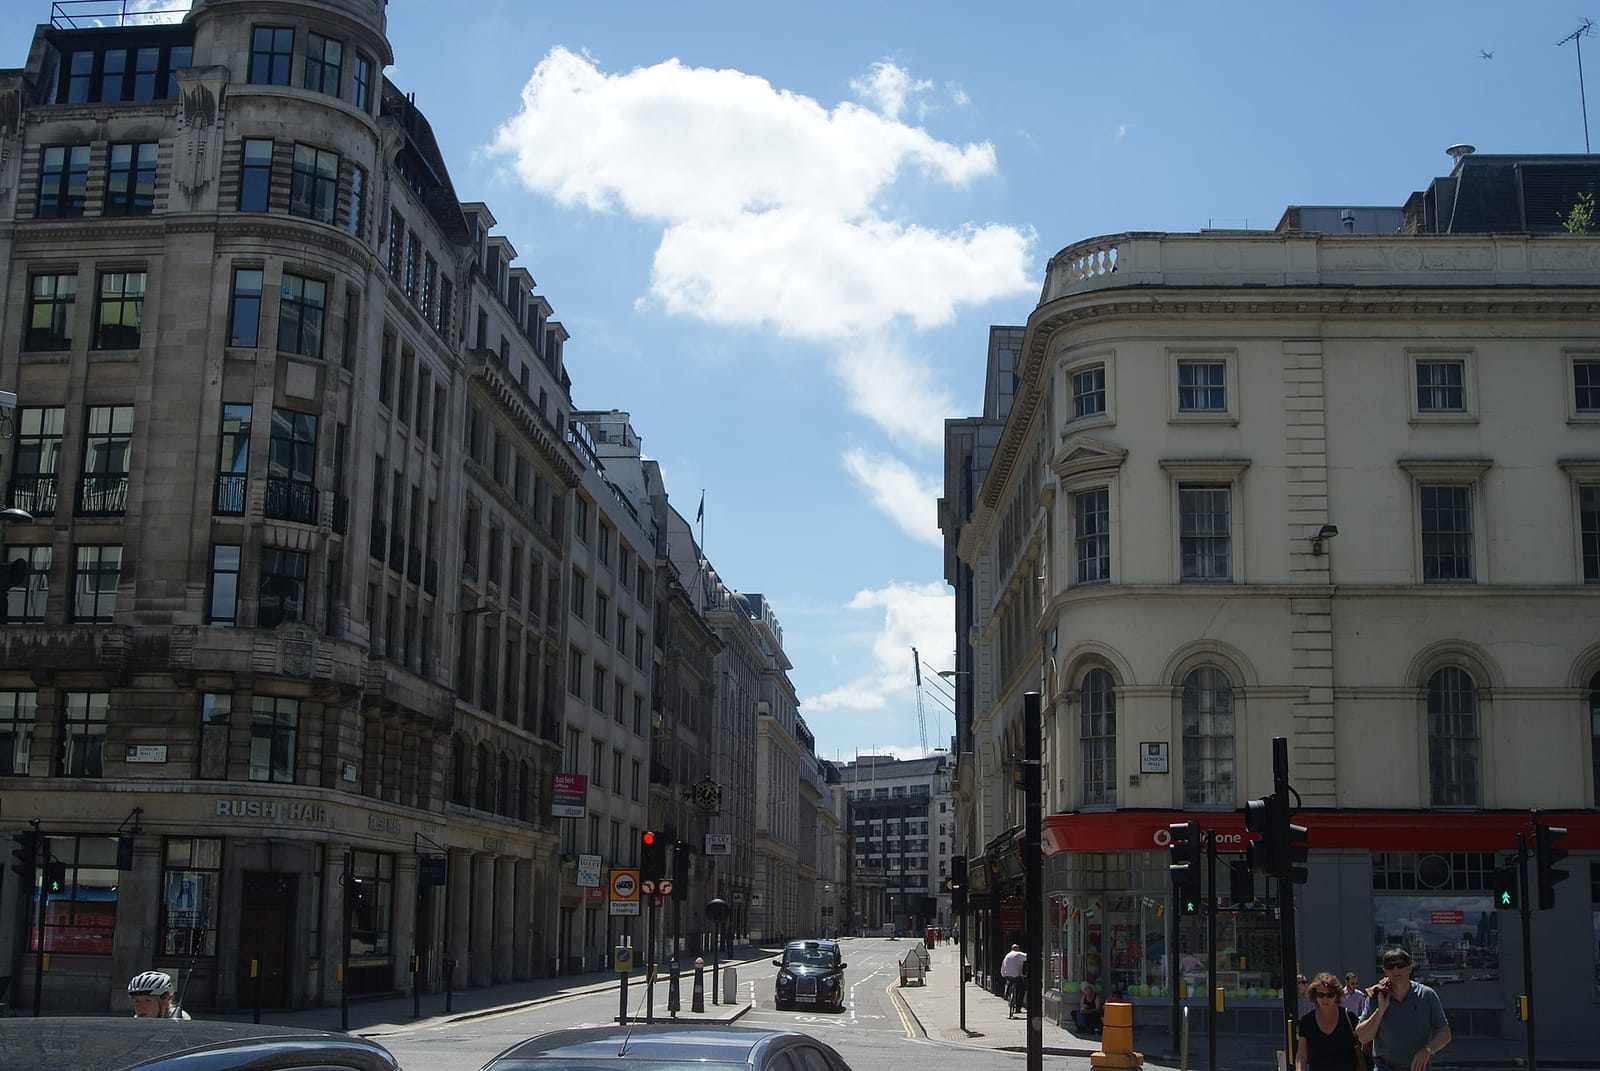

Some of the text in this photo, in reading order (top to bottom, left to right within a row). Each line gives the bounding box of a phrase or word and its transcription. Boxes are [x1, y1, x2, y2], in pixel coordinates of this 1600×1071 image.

[565, 776, 575, 784] let
[216, 799, 329, 823] RUSH HAIR
